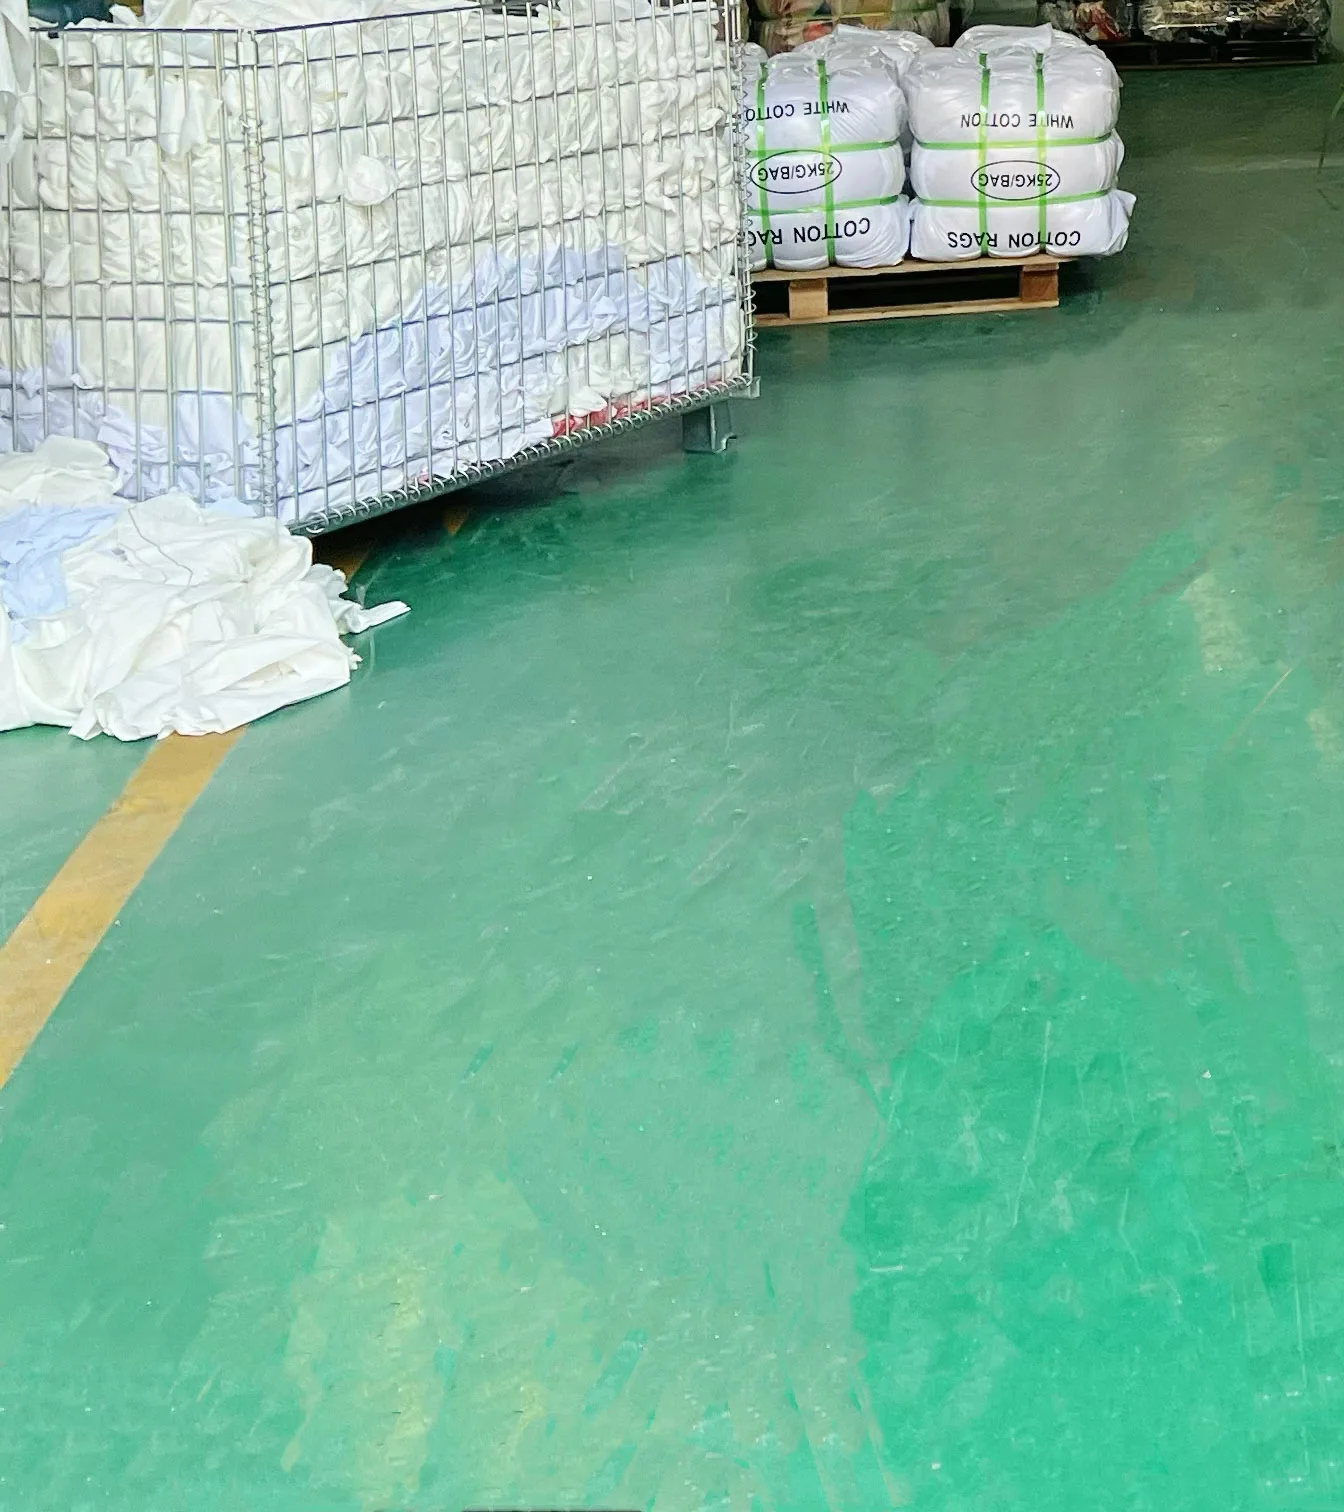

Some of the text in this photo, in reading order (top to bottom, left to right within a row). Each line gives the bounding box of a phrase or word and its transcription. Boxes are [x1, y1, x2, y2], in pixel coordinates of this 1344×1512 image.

[803, 100, 850, 116] WHITE
[960, 113, 1021, 129] COTTON
[757, 160, 834, 181] 25KG/BAG
[978, 173, 1053, 188] 25KG/BAG
[793, 217, 871, 242] COTTON
[947, 231, 1081, 249] COTTON RAGS
